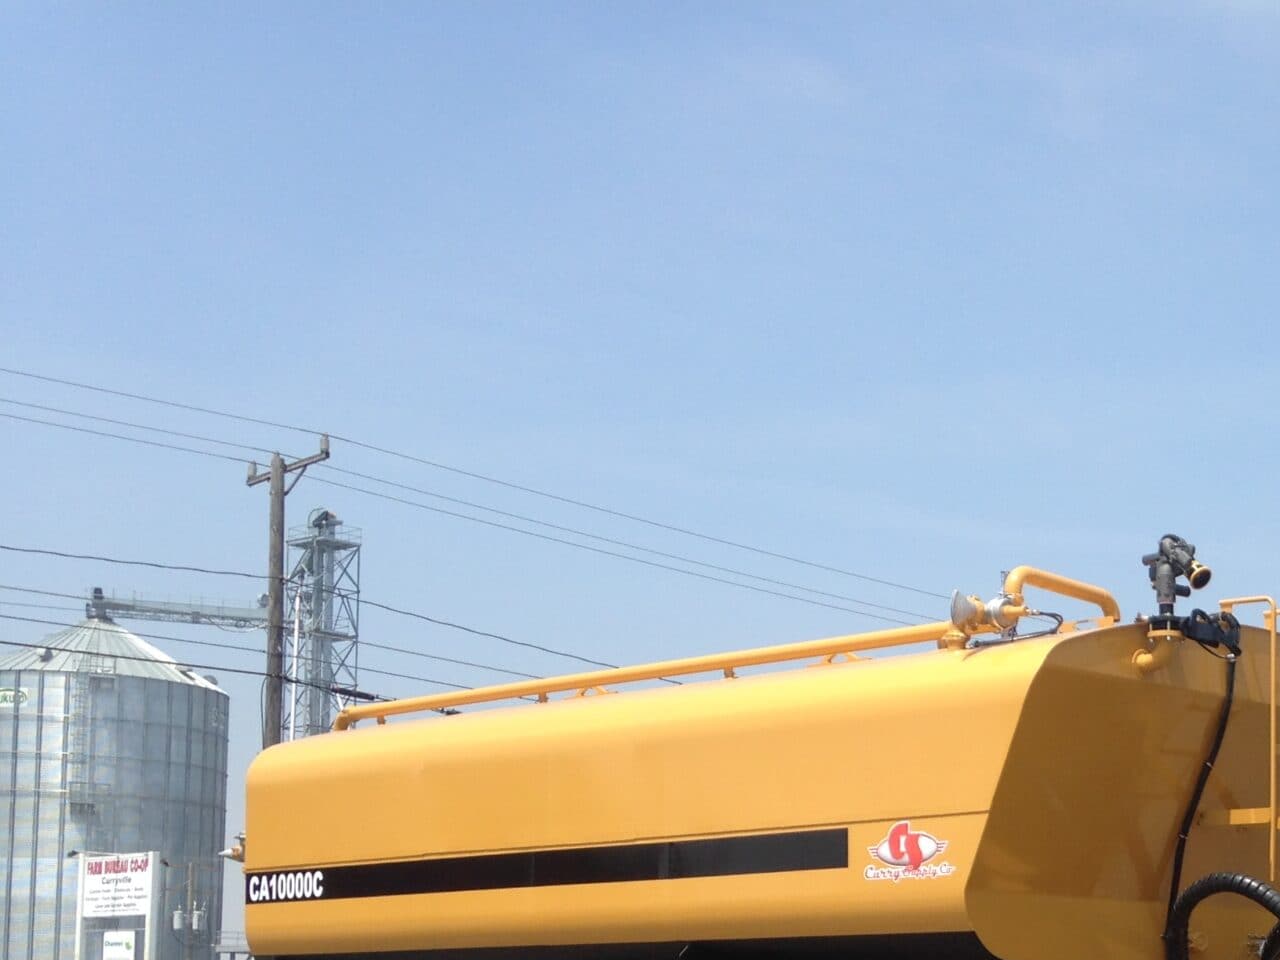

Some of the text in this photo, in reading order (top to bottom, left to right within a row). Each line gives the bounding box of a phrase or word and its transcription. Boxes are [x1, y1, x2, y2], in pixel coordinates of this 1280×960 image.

[87, 857, 149, 875] FARM BUREAU CO-OP
[864, 866, 900, 880] Curry
[101, 876, 132, 887] Curryville
[249, 870, 324, 902] CA10000C
